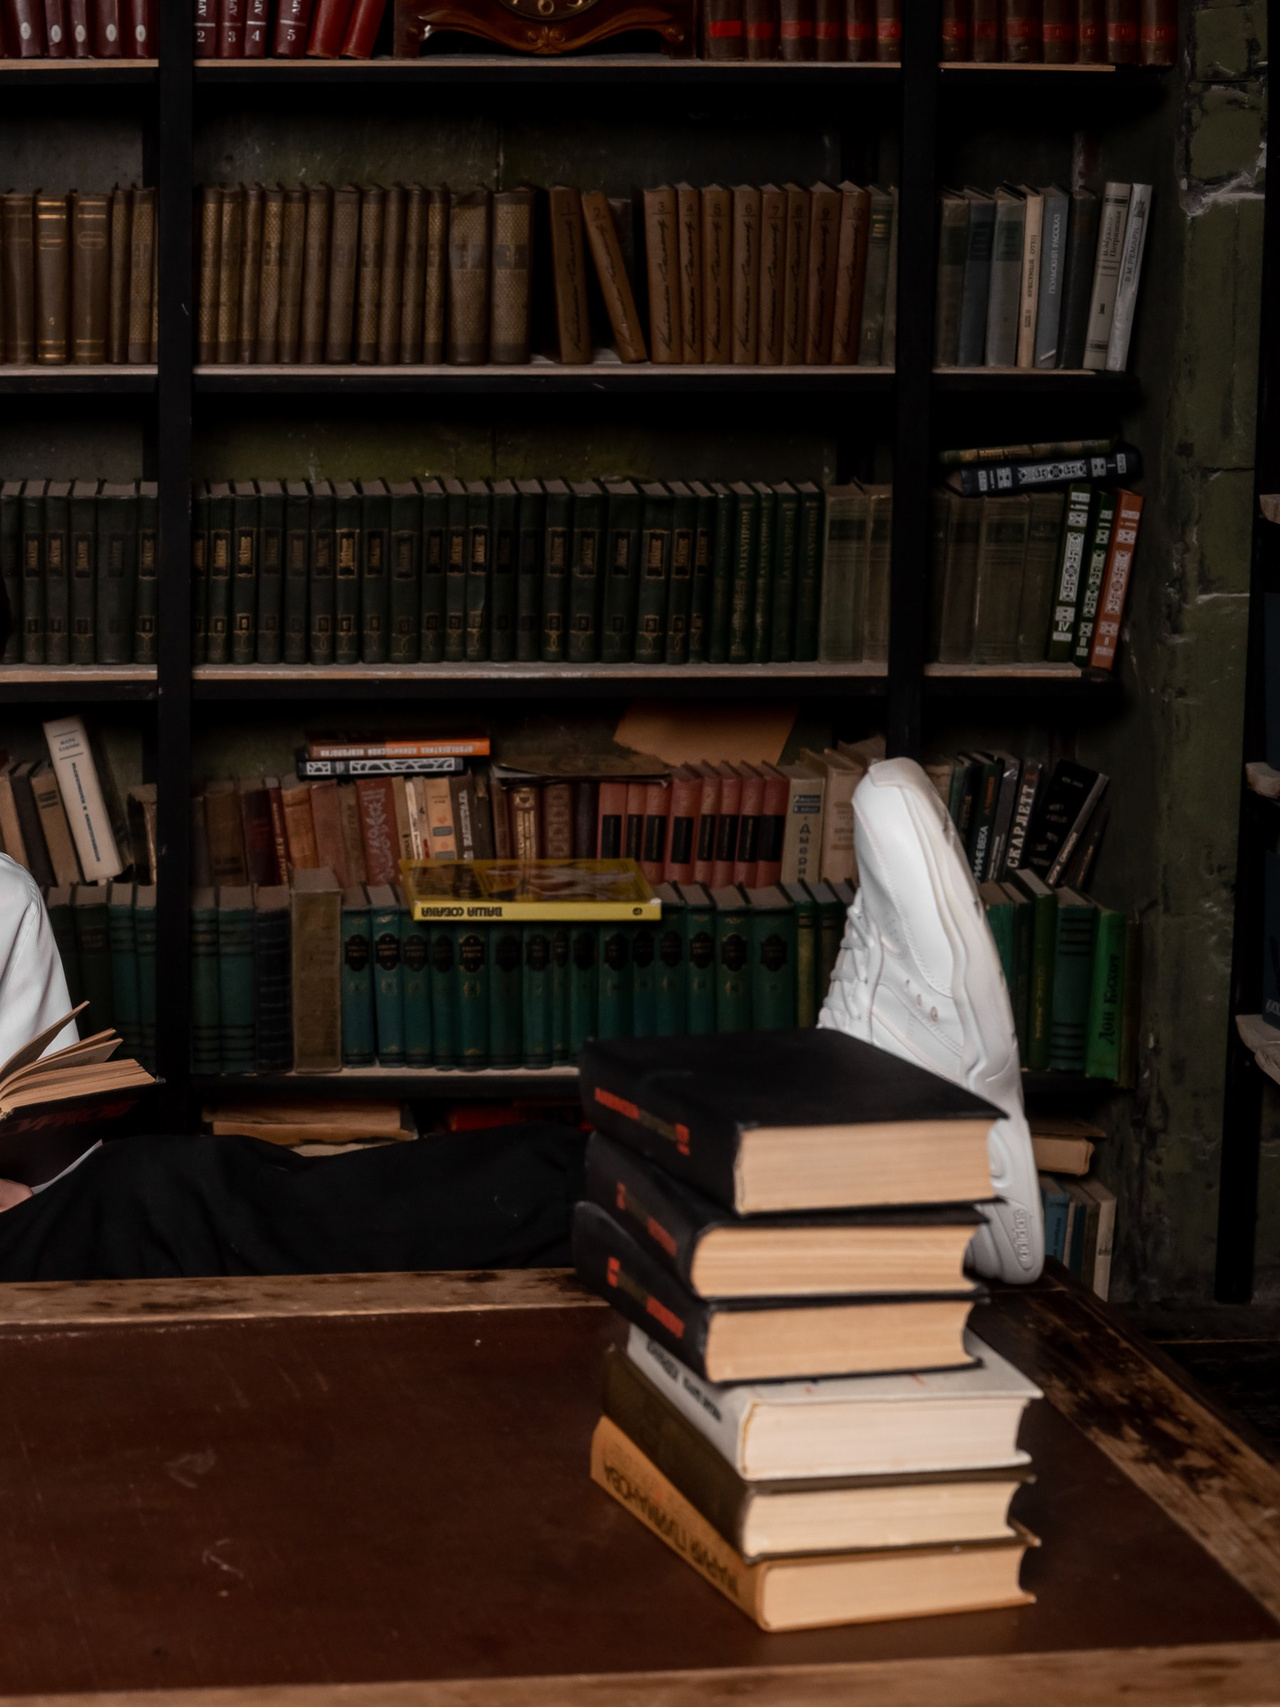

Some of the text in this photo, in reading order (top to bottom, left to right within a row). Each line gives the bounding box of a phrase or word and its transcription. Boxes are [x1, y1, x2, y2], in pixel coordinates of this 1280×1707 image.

[197, 31, 205, 42] 2
[228, 31, 236, 42] 3
[251, 30, 260, 41] 4
[287, 29, 296, 41] 5
[1029, 234, 1037, 254] ОТЕЦ
[1048, 214, 1061, 294] ПОЛЬСКИЙ РАССКАЗ
[1058, 621, 1069, 631] IV
[1007, 784, 1035, 868] СКАРЛЕТТ
[421, 907, 502, 917] ВАША СОБАКА
[1098, 1012, 1115, 1045] Дон
[1013, 1208, 1030, 1262] adidas
